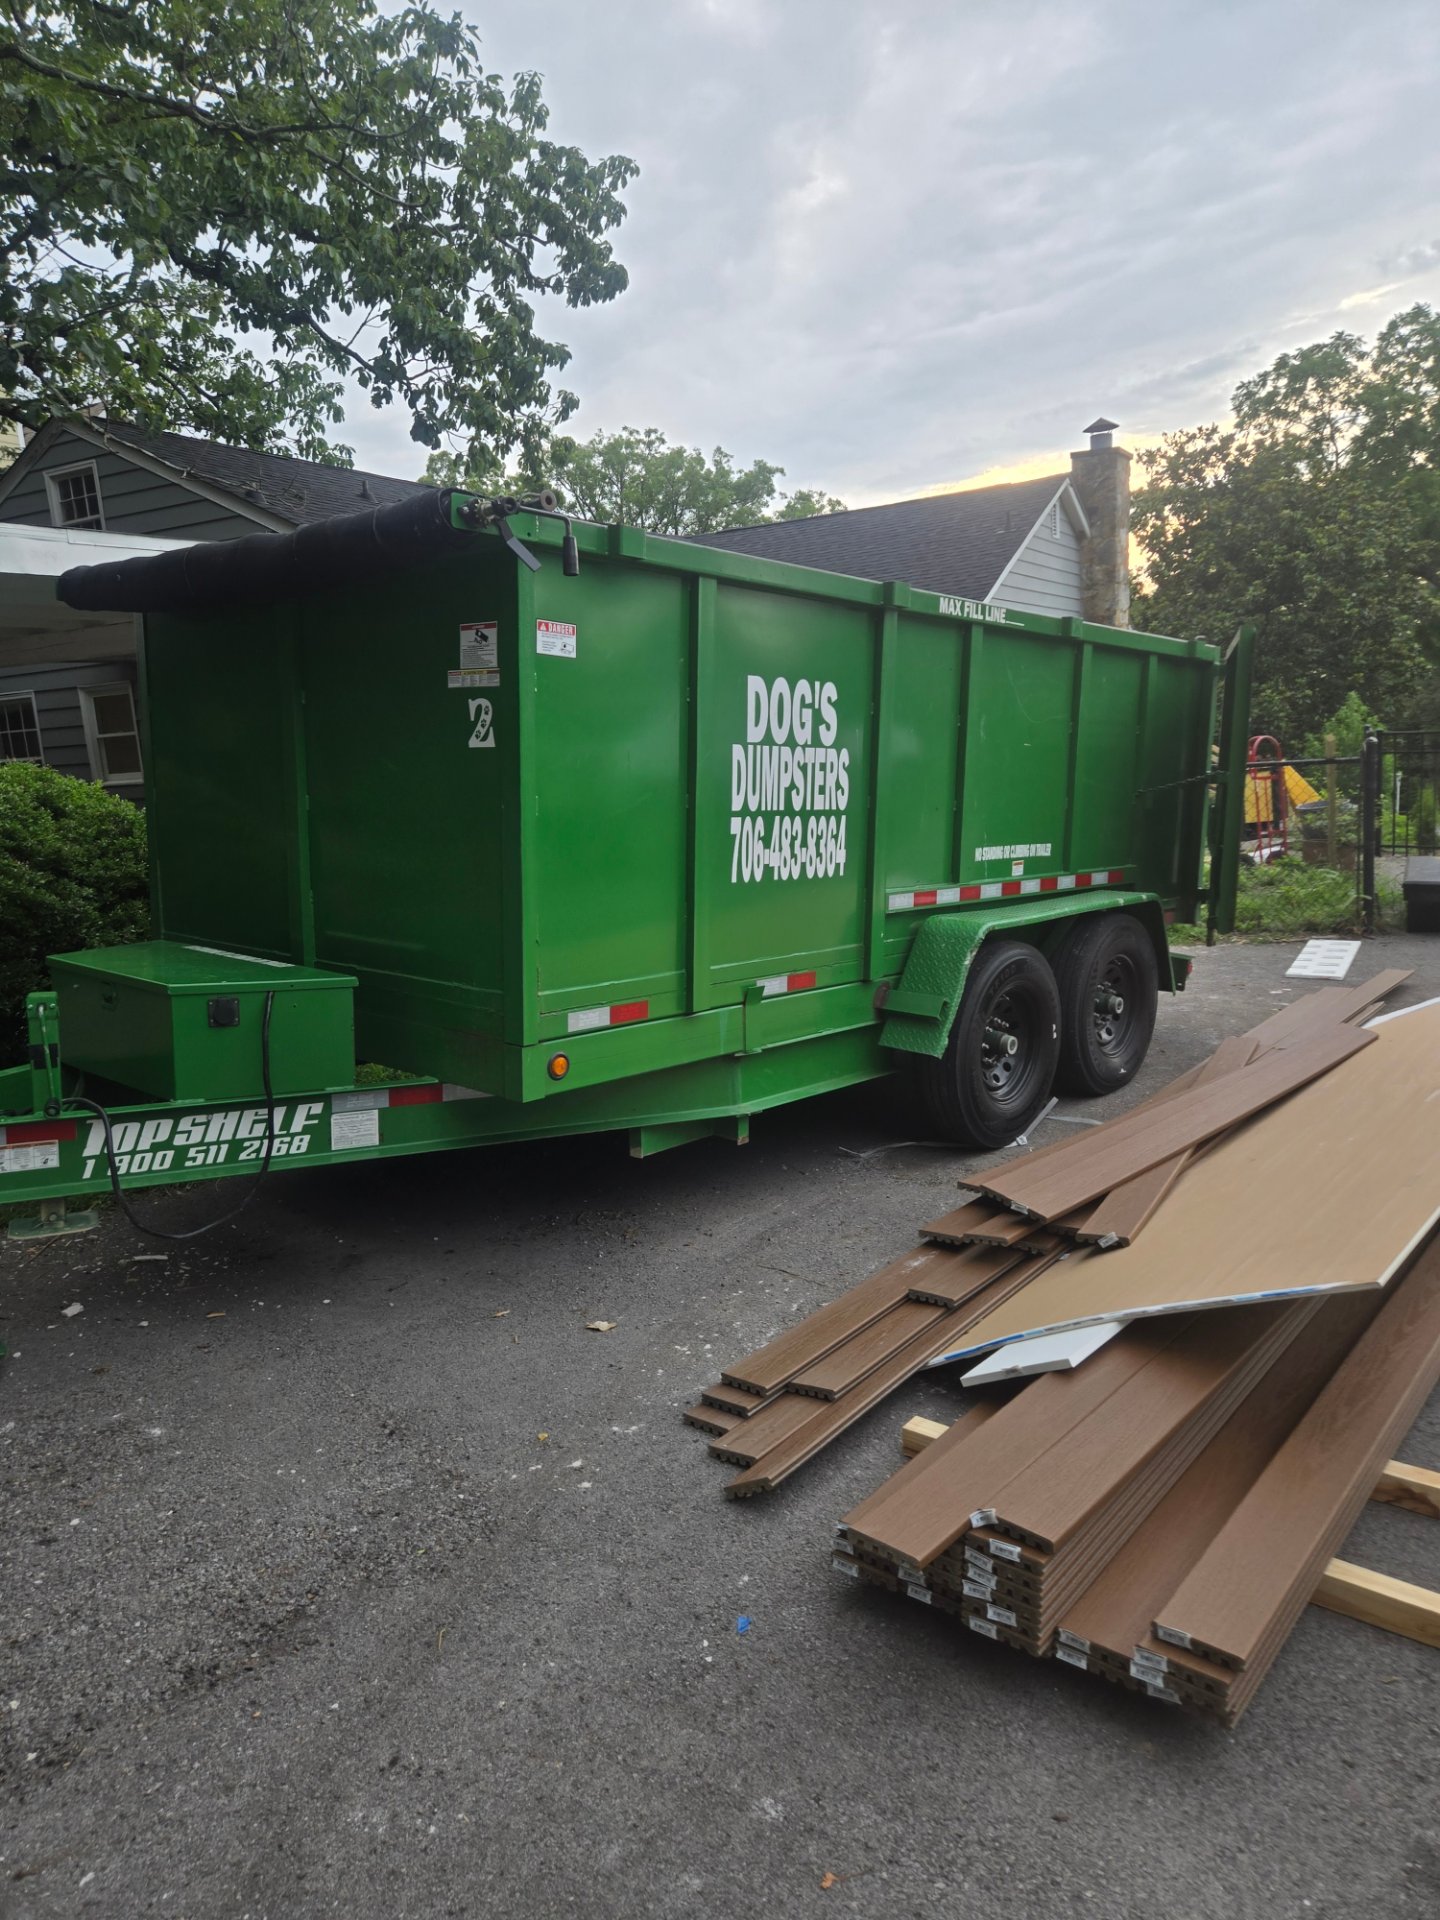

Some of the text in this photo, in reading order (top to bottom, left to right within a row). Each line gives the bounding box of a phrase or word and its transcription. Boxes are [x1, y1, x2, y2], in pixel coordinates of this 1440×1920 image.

[548, 622, 574, 636] DANGER
[939, 597, 1007, 624] MAX FILL LINE
[468, 698, 496, 748] 2
[747, 675, 838, 747] DOG'S
[731, 744, 850, 812] DUMPSTERS
[730, 815, 847, 883] 706-483-8364
[82, 1159, 96, 1180] 1
[184, 1143, 229, 1167] 511
[238, 1134, 311, 1161] 2168
